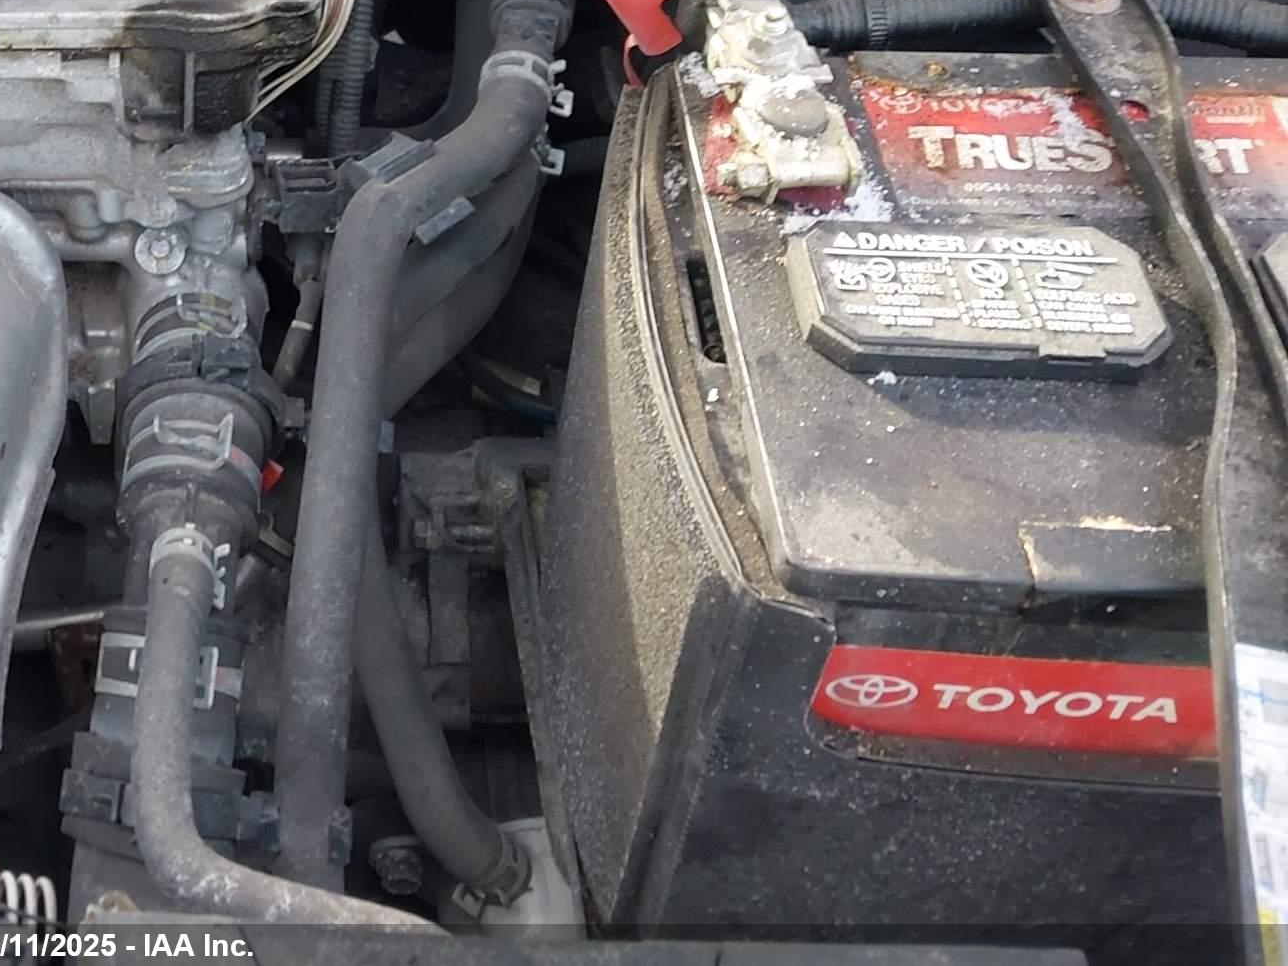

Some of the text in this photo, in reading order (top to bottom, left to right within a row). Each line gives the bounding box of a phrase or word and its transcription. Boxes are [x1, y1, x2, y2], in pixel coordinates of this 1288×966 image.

[857, 233, 968, 252] DANGER
[991, 237, 1095, 256] POISON
[933, 684, 1178, 724] TOYOTA
